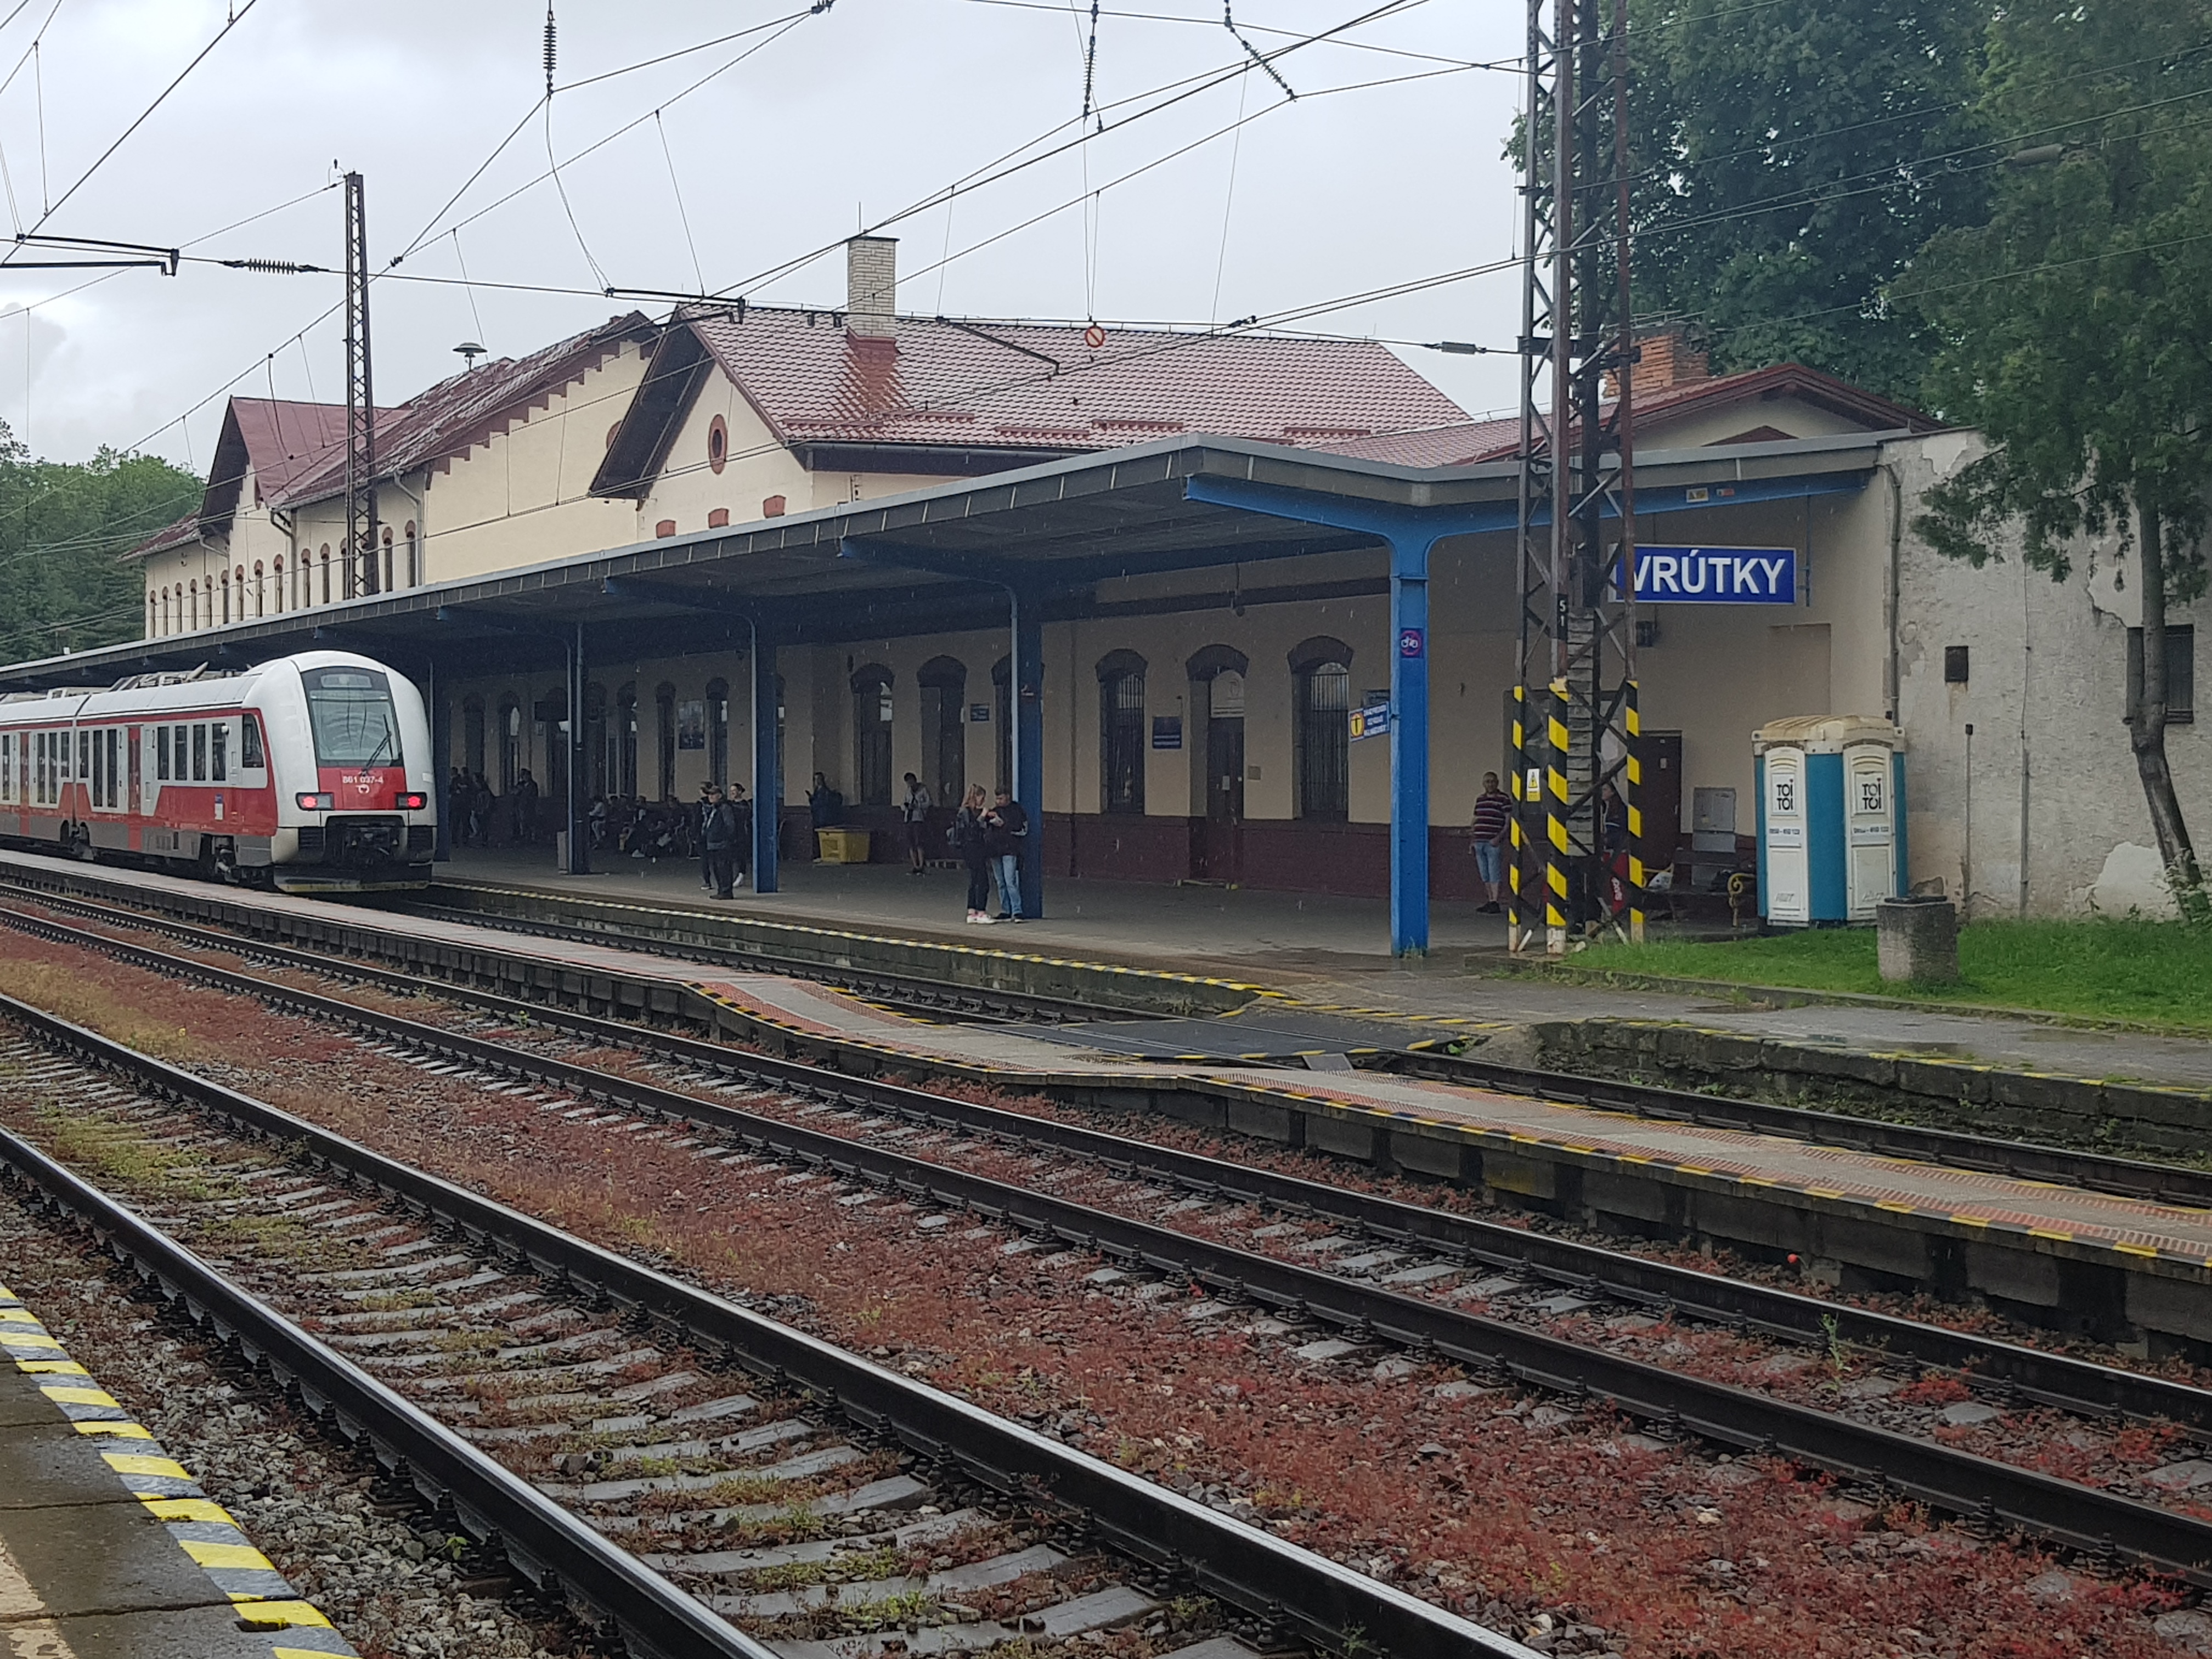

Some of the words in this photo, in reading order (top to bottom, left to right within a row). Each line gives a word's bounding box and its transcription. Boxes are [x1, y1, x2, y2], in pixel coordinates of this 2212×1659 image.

[1634, 549, 1785, 594] VRÚTKY
[1776, 798, 1793, 810] TOI
[1862, 797, 1882, 810] TOI
